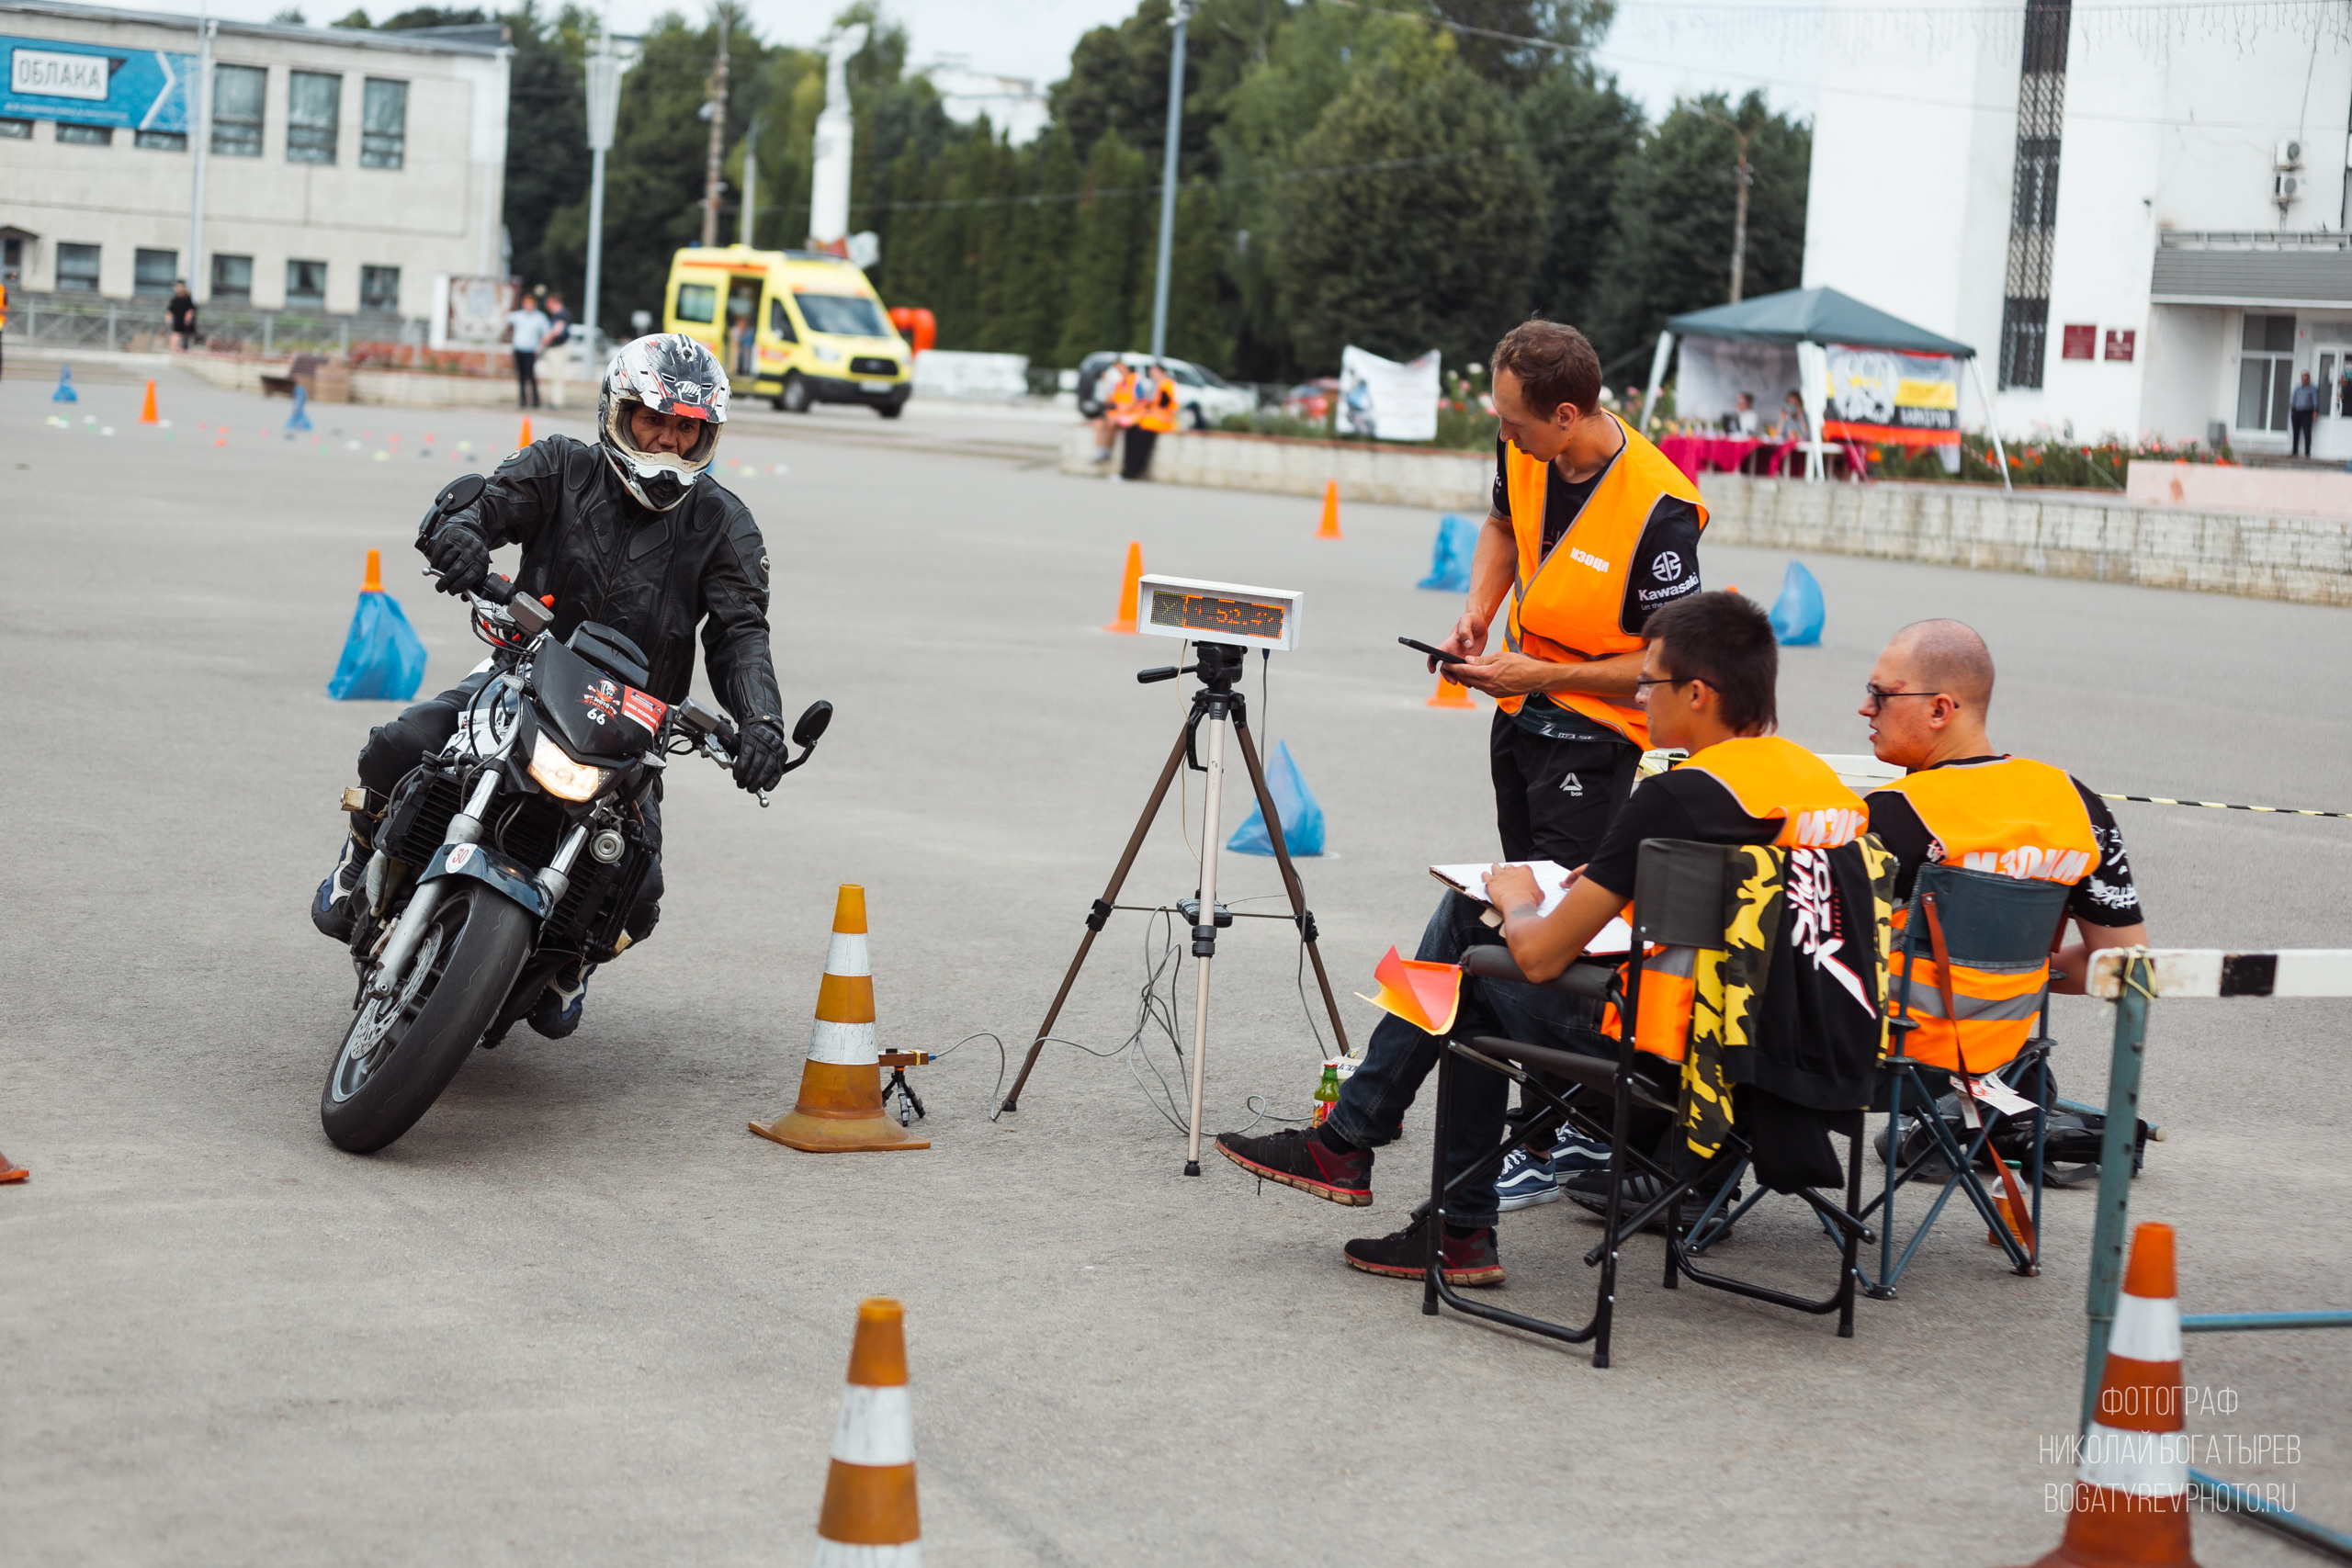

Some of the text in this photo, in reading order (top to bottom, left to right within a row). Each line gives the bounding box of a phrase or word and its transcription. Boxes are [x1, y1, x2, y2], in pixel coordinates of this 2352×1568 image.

[18, 58, 102, 89] ОБЛАКА
[1638, 571, 1699, 602] Kawasaki
[587, 707, 606, 726] 66
[452, 848, 469, 864] 30
